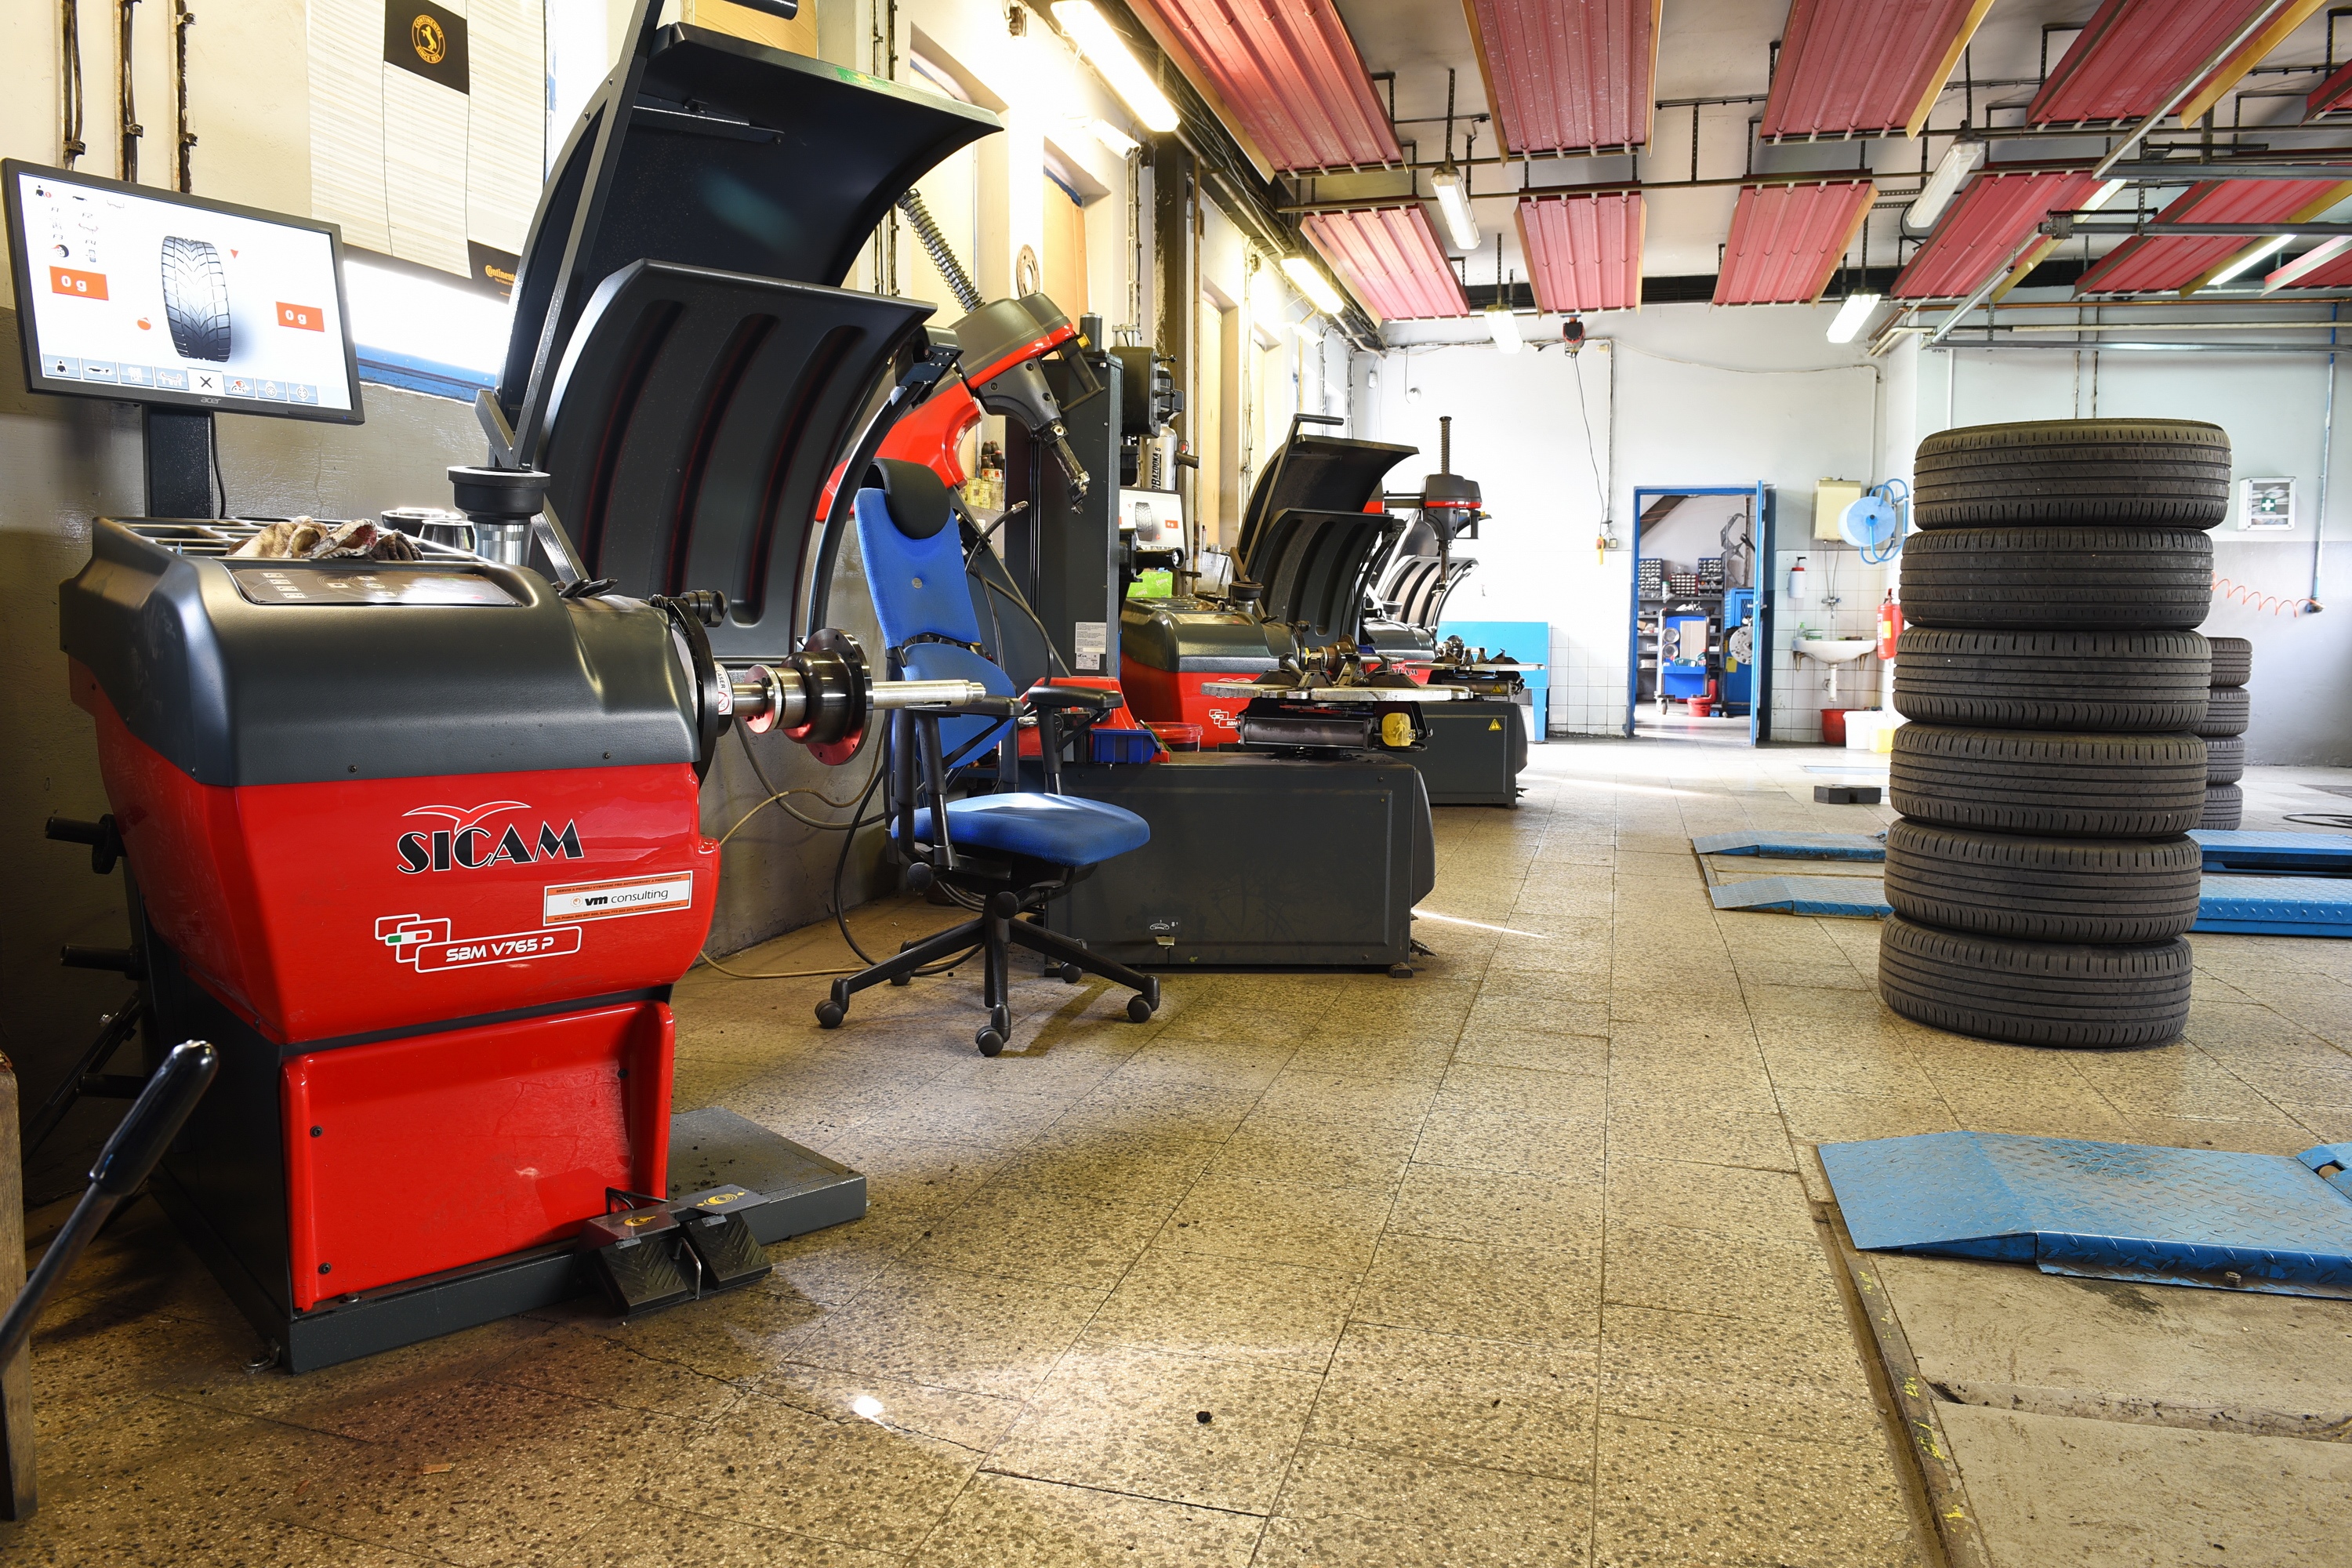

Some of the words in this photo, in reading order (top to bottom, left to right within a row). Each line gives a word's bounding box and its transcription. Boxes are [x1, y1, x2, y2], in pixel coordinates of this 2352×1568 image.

[414, 16, 443, 39] CONTINENTAL
[416, 45, 430, 61] SINCE
[485, 265, 516, 281] Continent
[61, 275, 71, 287] 0
[75, 280, 88, 292] g
[285, 310, 294, 321] 0
[297, 314, 307, 325] g
[397, 818, 584, 874] SICAM
[585, 896, 608, 906] vm
[611, 890, 669, 903] consulting
[445, 945, 487, 962] SBM
[491, 938, 538, 956] V765
[541, 936, 554, 950] P
